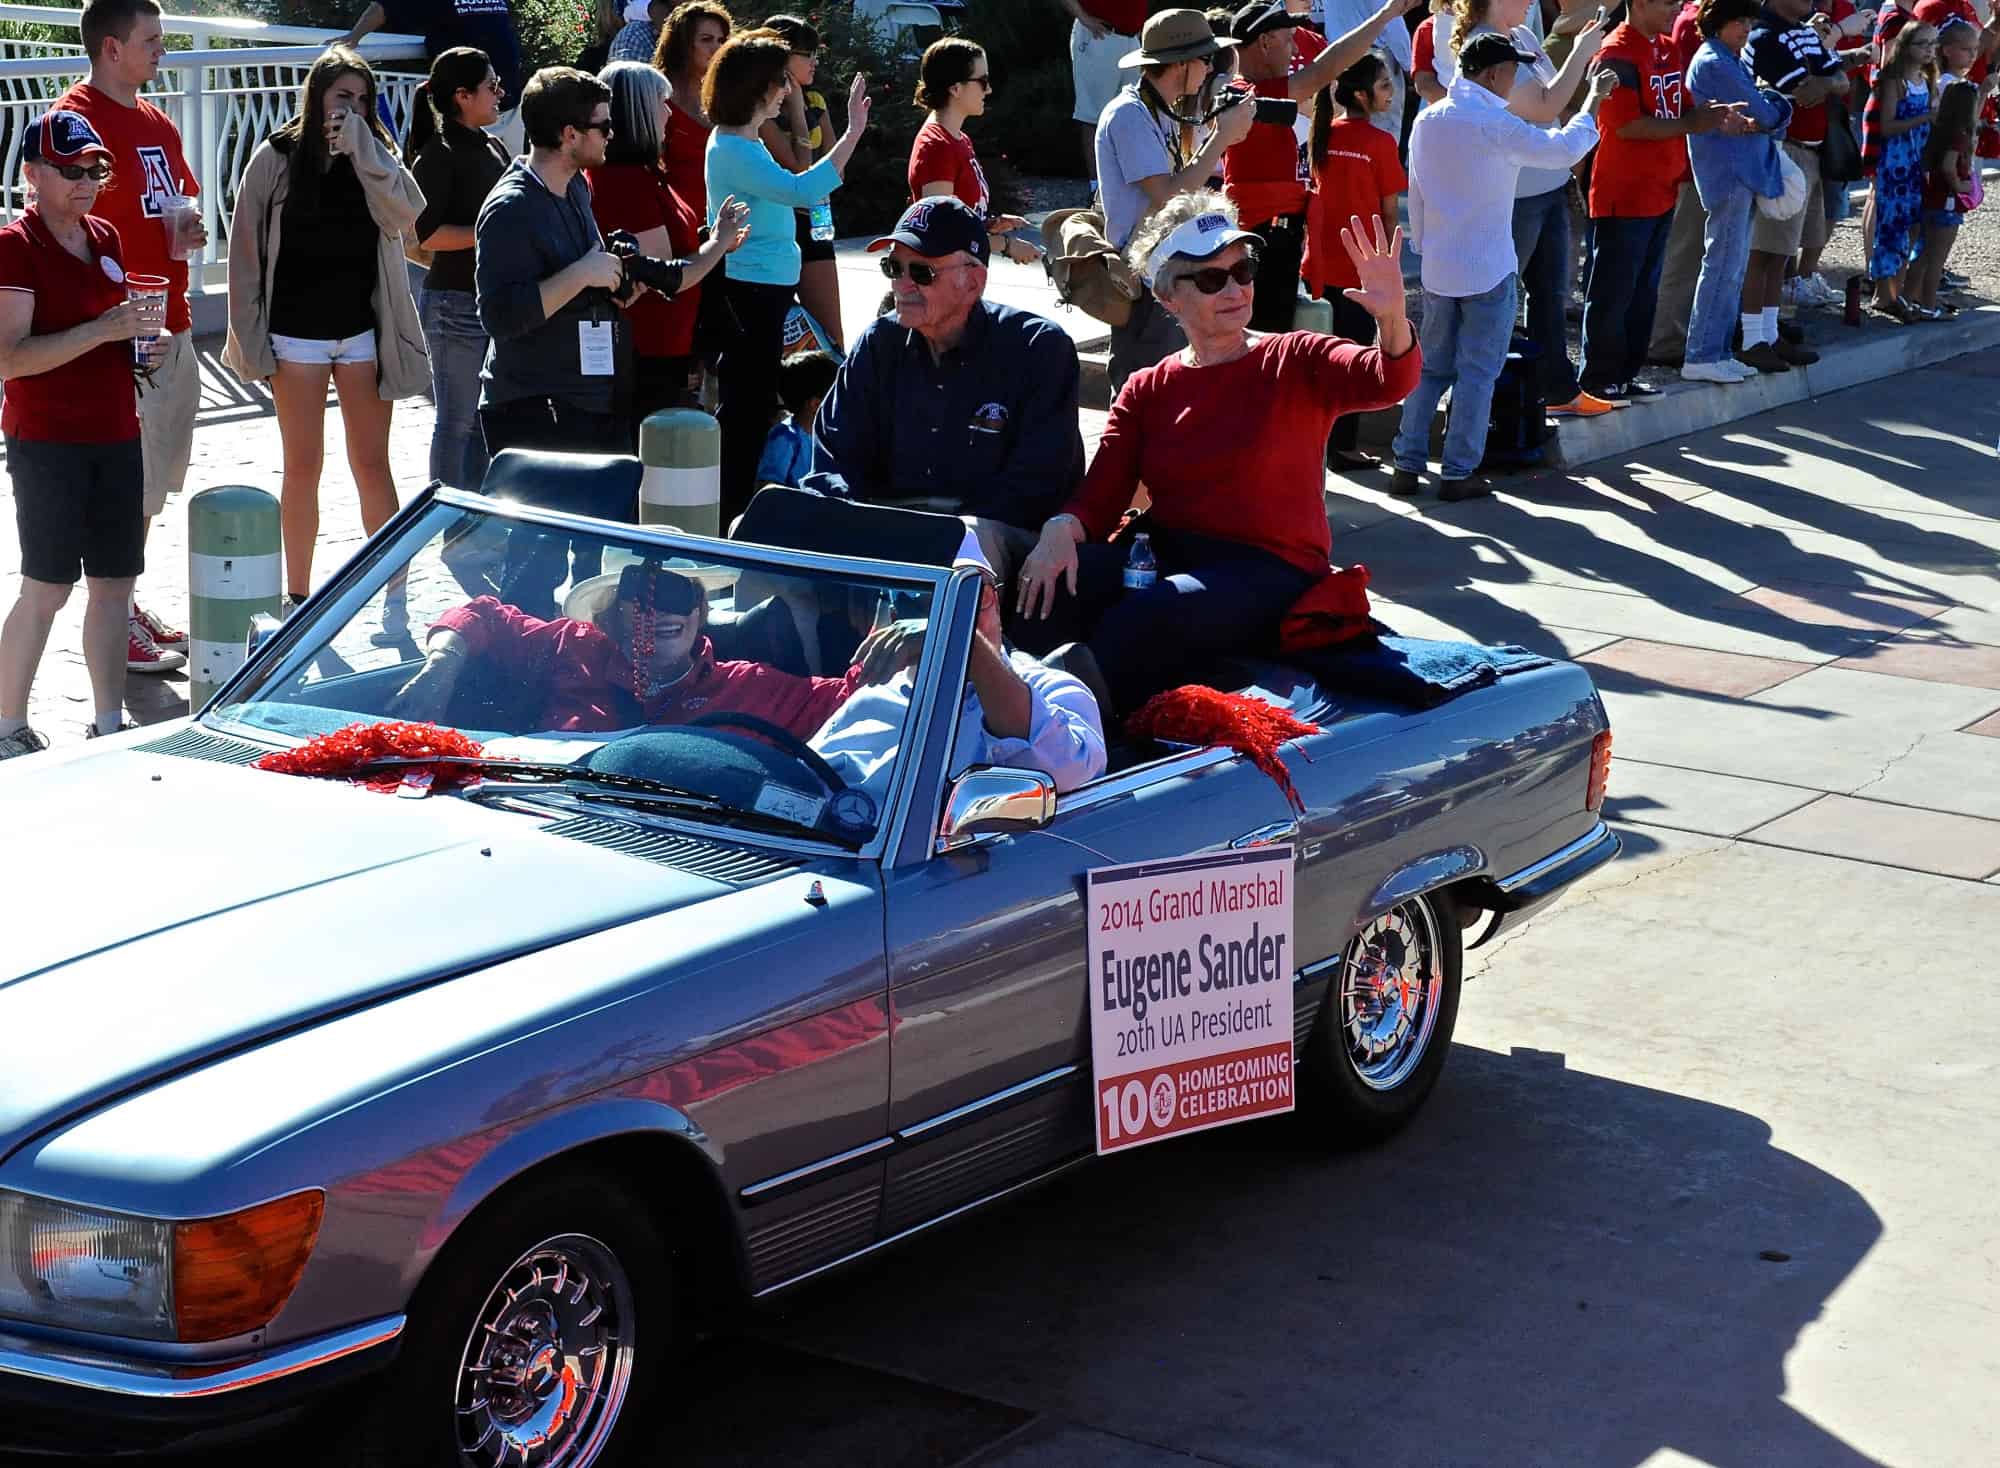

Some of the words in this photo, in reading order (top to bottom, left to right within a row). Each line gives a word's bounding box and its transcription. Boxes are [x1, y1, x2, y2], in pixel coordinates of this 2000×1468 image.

[137, 145, 180, 218] A
[902, 203, 936, 232] A
[1101, 899, 1144, 932] 2014
[1150, 880, 1203, 923] Grand
[1210, 870, 1284, 914] Marshal
[1102, 949, 1191, 1021] Eugene
[1199, 921, 1286, 993] Sander
[1117, 1018, 1155, 1057] 20th
[1161, 1013, 1186, 1048] UA
[1192, 998, 1273, 1041] President
[1178, 1052, 1290, 1094] HOMECOMING
[1179, 1076, 1290, 1119] CELEBRATION
